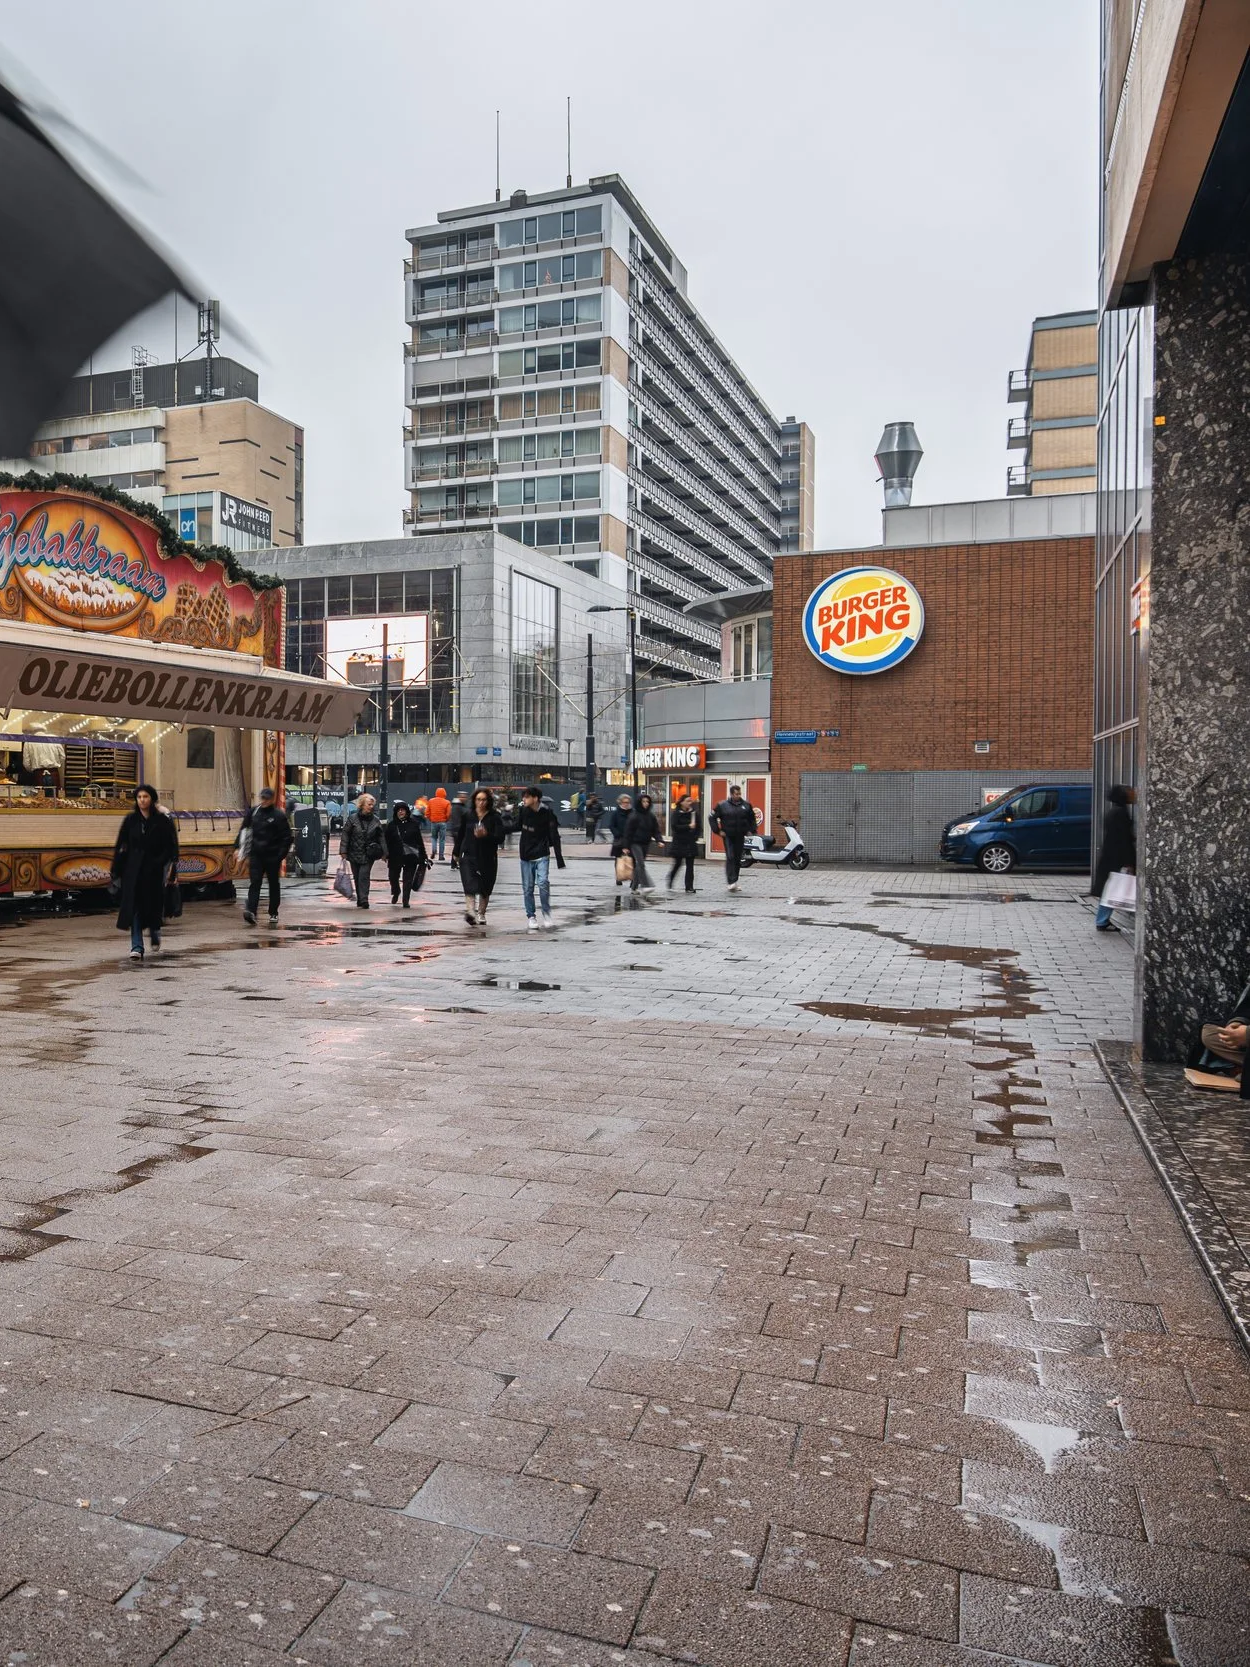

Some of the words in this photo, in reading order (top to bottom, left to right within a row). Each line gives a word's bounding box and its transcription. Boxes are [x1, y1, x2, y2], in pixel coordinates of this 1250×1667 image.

[238, 504, 255, 519] JOHN
[255, 508, 270, 524] REED
[238, 518, 270, 536] FITNESS
[818, 586, 907, 627] BURGER
[821, 604, 911, 653] KING
[19, 657, 334, 725] OLIEBOLLENKRAAM
[664, 746, 698, 768] KING
